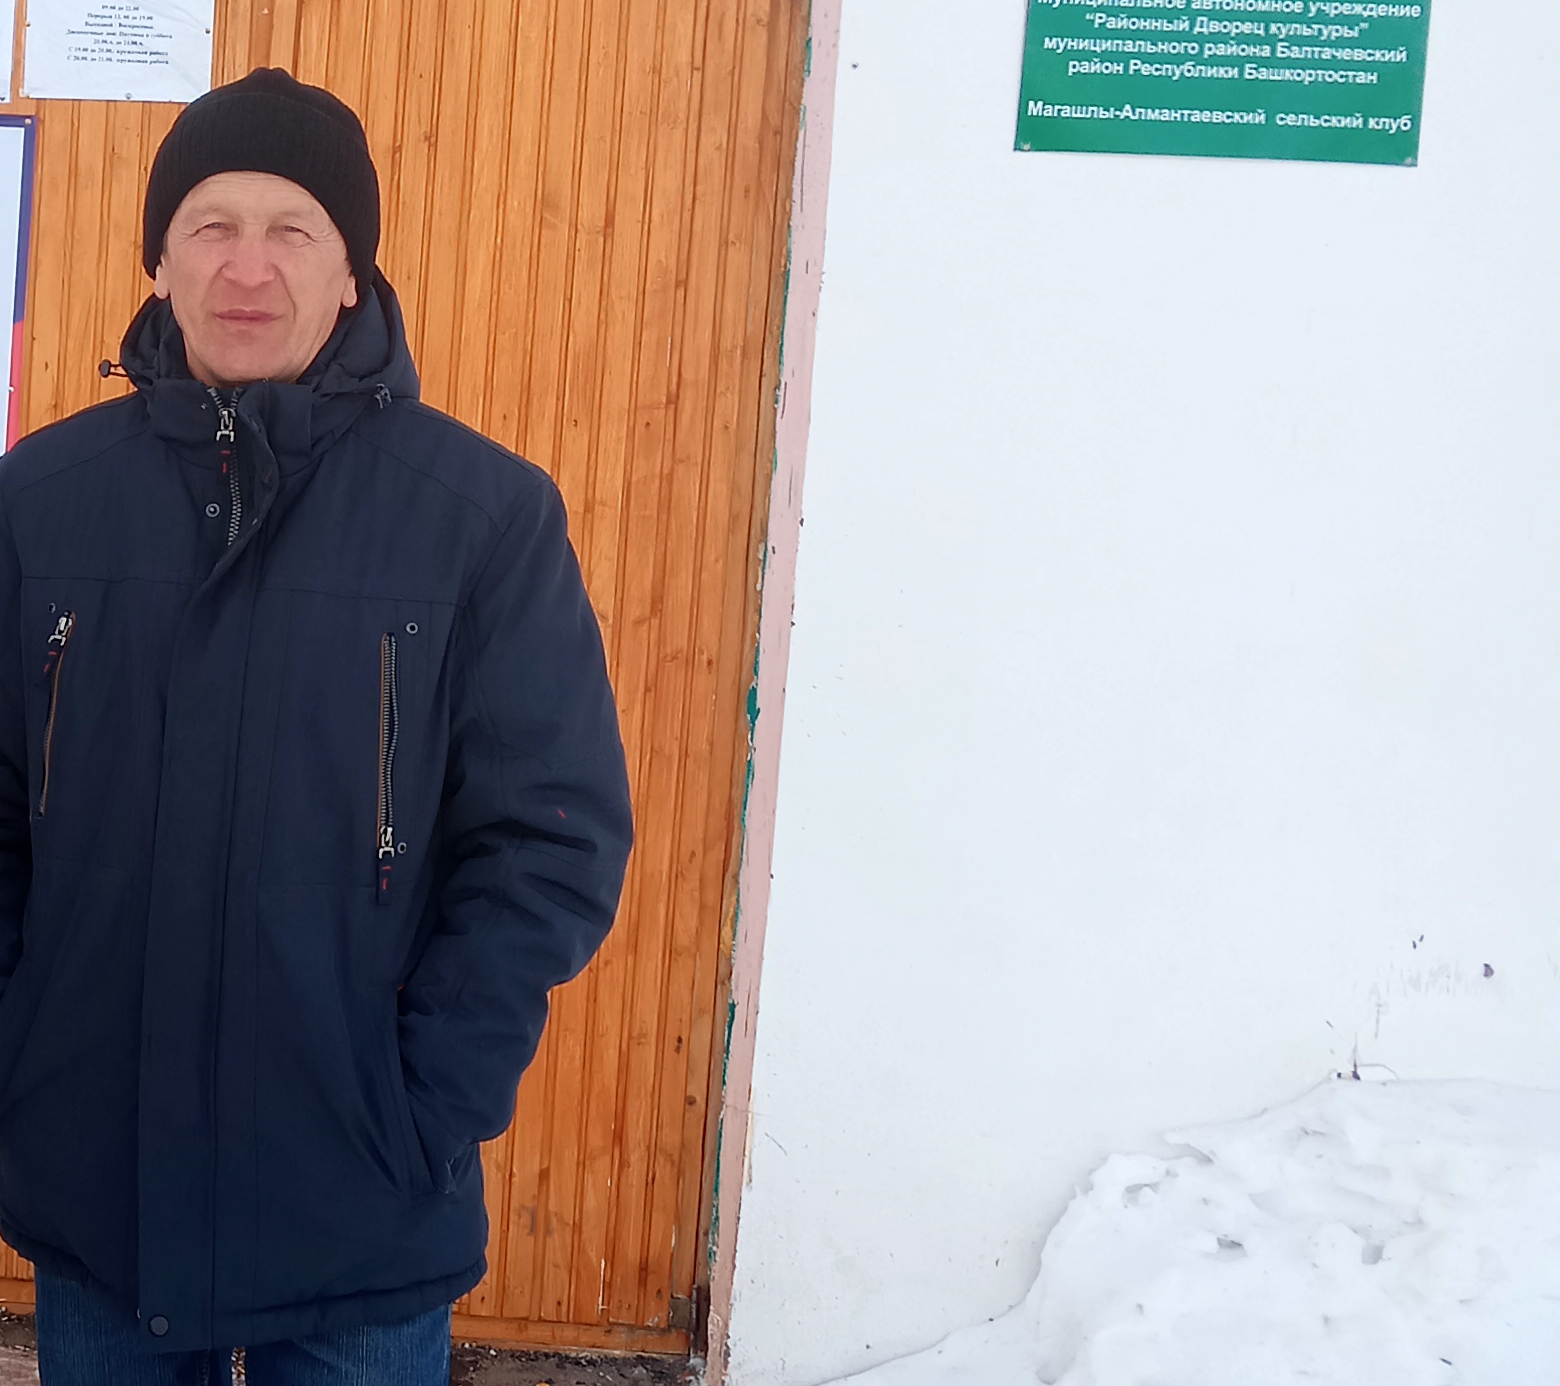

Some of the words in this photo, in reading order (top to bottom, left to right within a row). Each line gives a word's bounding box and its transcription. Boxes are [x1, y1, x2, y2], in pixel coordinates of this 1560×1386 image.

[1308, 0, 1422, 18] учреждение
[1193, 16, 1265, 37] Дворец
[1043, 36, 1200, 55] муниципального
[1203, 39, 1272, 59] района
[1276, 42, 1408, 63] Балтачевский
[1067, 57, 1124, 77] район
[1128, 59, 1239, 81] Республики
[1244, 63, 1379, 85] Башкортостан
[1026, 100, 1267, 126] Магашлы-Алмантаевский
[1276, 112, 1365, 130] сельский
[1368, 115, 1412, 134] клуб
